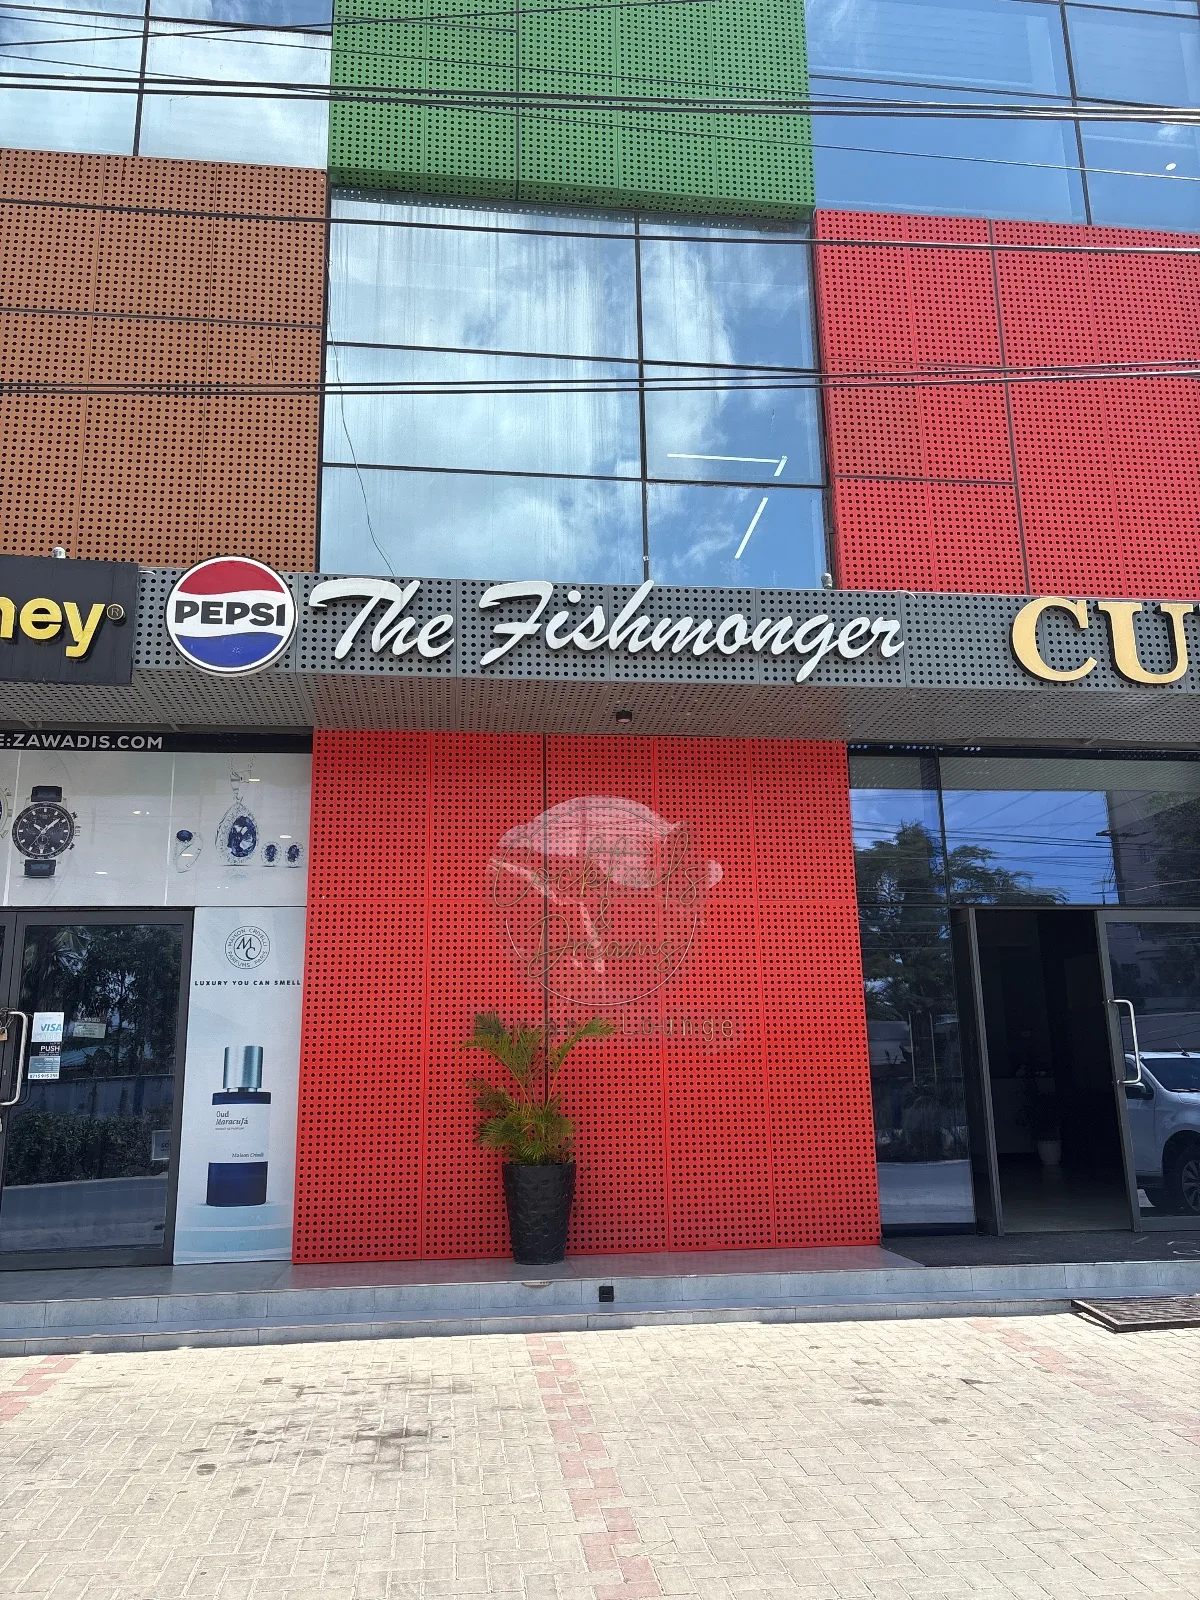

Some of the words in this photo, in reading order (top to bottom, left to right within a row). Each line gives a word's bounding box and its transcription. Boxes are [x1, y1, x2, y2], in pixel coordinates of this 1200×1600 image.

[174, 600, 286, 628] PEPSI
[310, 578, 456, 662] The
[479, 579, 905, 683] Fishmonger
[1012, 597, 1200, 684] CU
[526, 913, 690, 978] Dreams
[620, 1010, 734, 1042] Lounge
